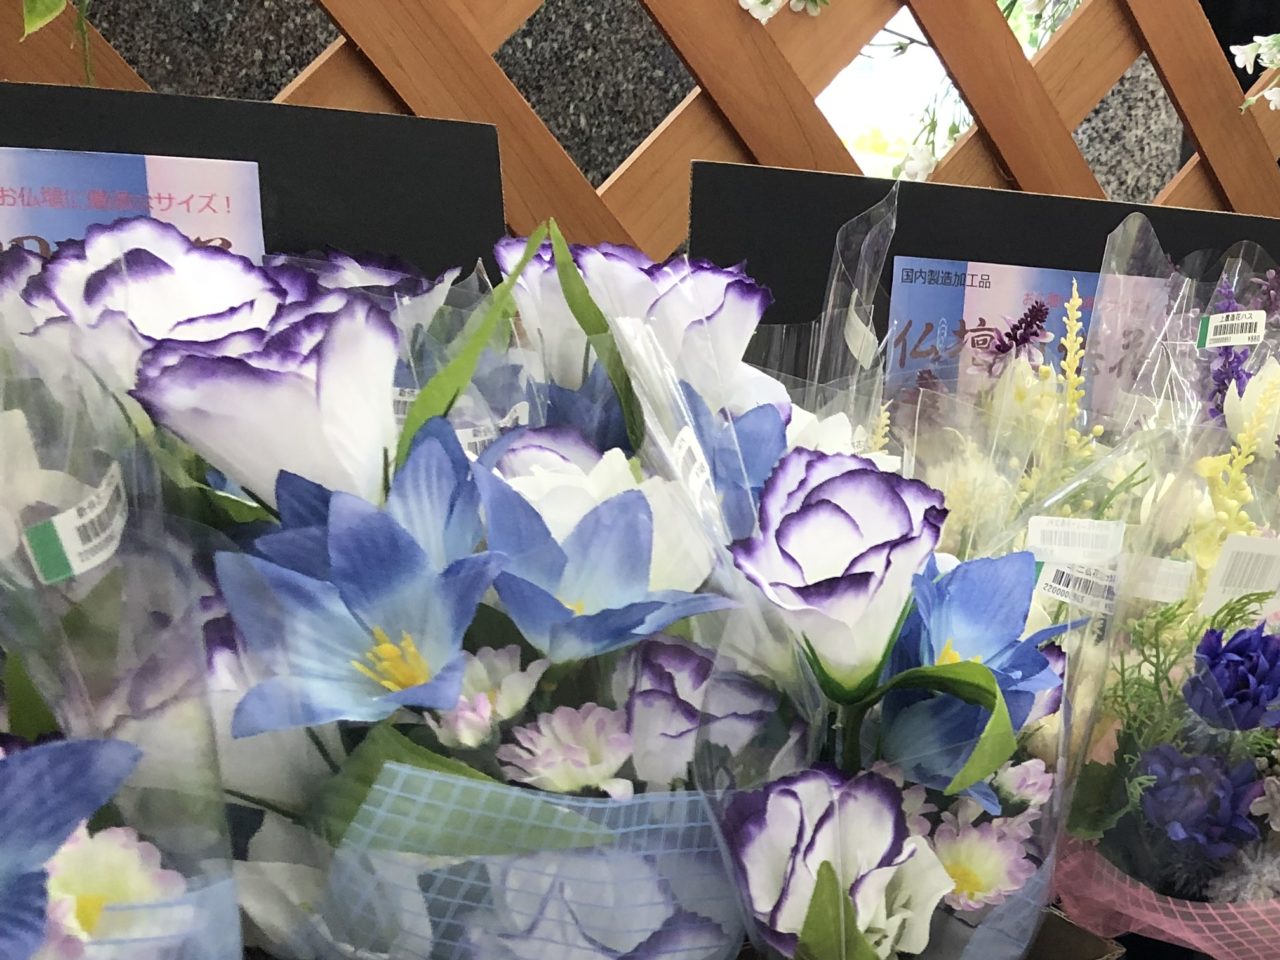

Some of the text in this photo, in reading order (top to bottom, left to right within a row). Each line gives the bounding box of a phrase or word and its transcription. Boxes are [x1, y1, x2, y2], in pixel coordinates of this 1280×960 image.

[901, 267, 992, 289] 国内製造加工品
